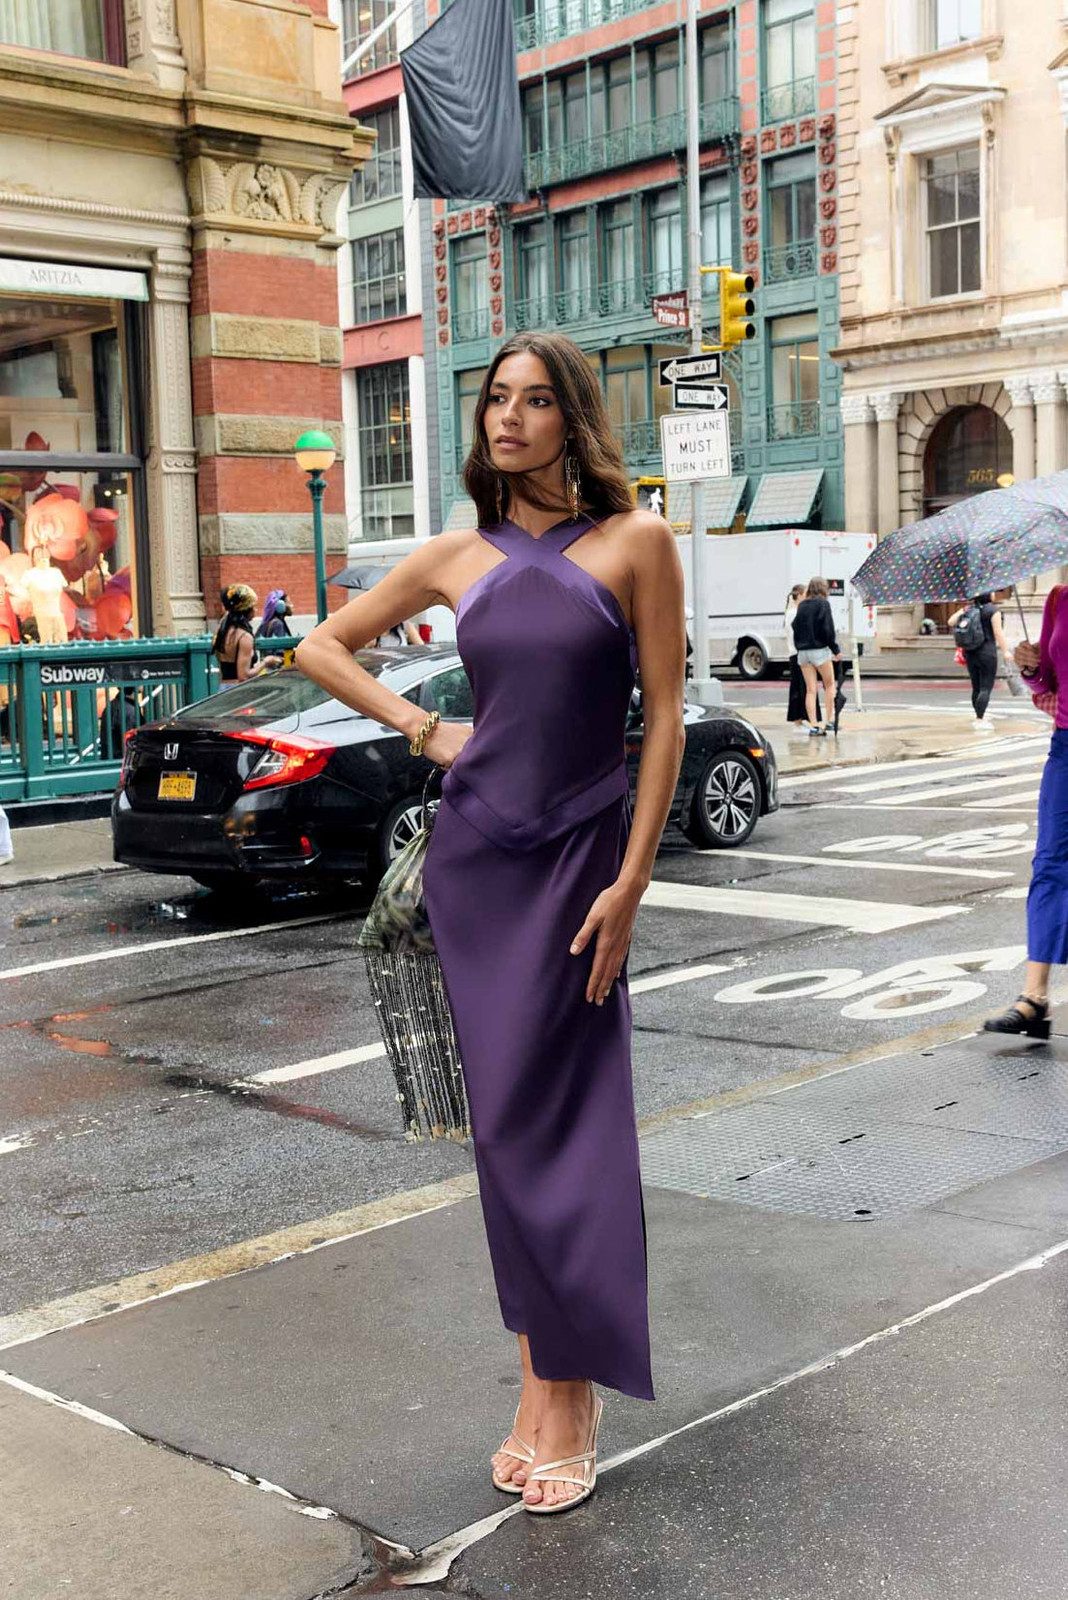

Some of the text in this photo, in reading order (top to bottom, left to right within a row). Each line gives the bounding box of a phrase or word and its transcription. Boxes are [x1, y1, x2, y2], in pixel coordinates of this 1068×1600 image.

[30, 268, 82, 284] ARITZIA
[668, 362, 713, 377] ONE WAY
[682, 391, 700, 402] ONE
[668, 420, 721, 435] LEFT LANE
[680, 439, 711, 454] MUST
[670, 459, 724, 473] TURN LEFT
[967, 468, 994, 484] 565
[41, 665, 105, 684] Subway
